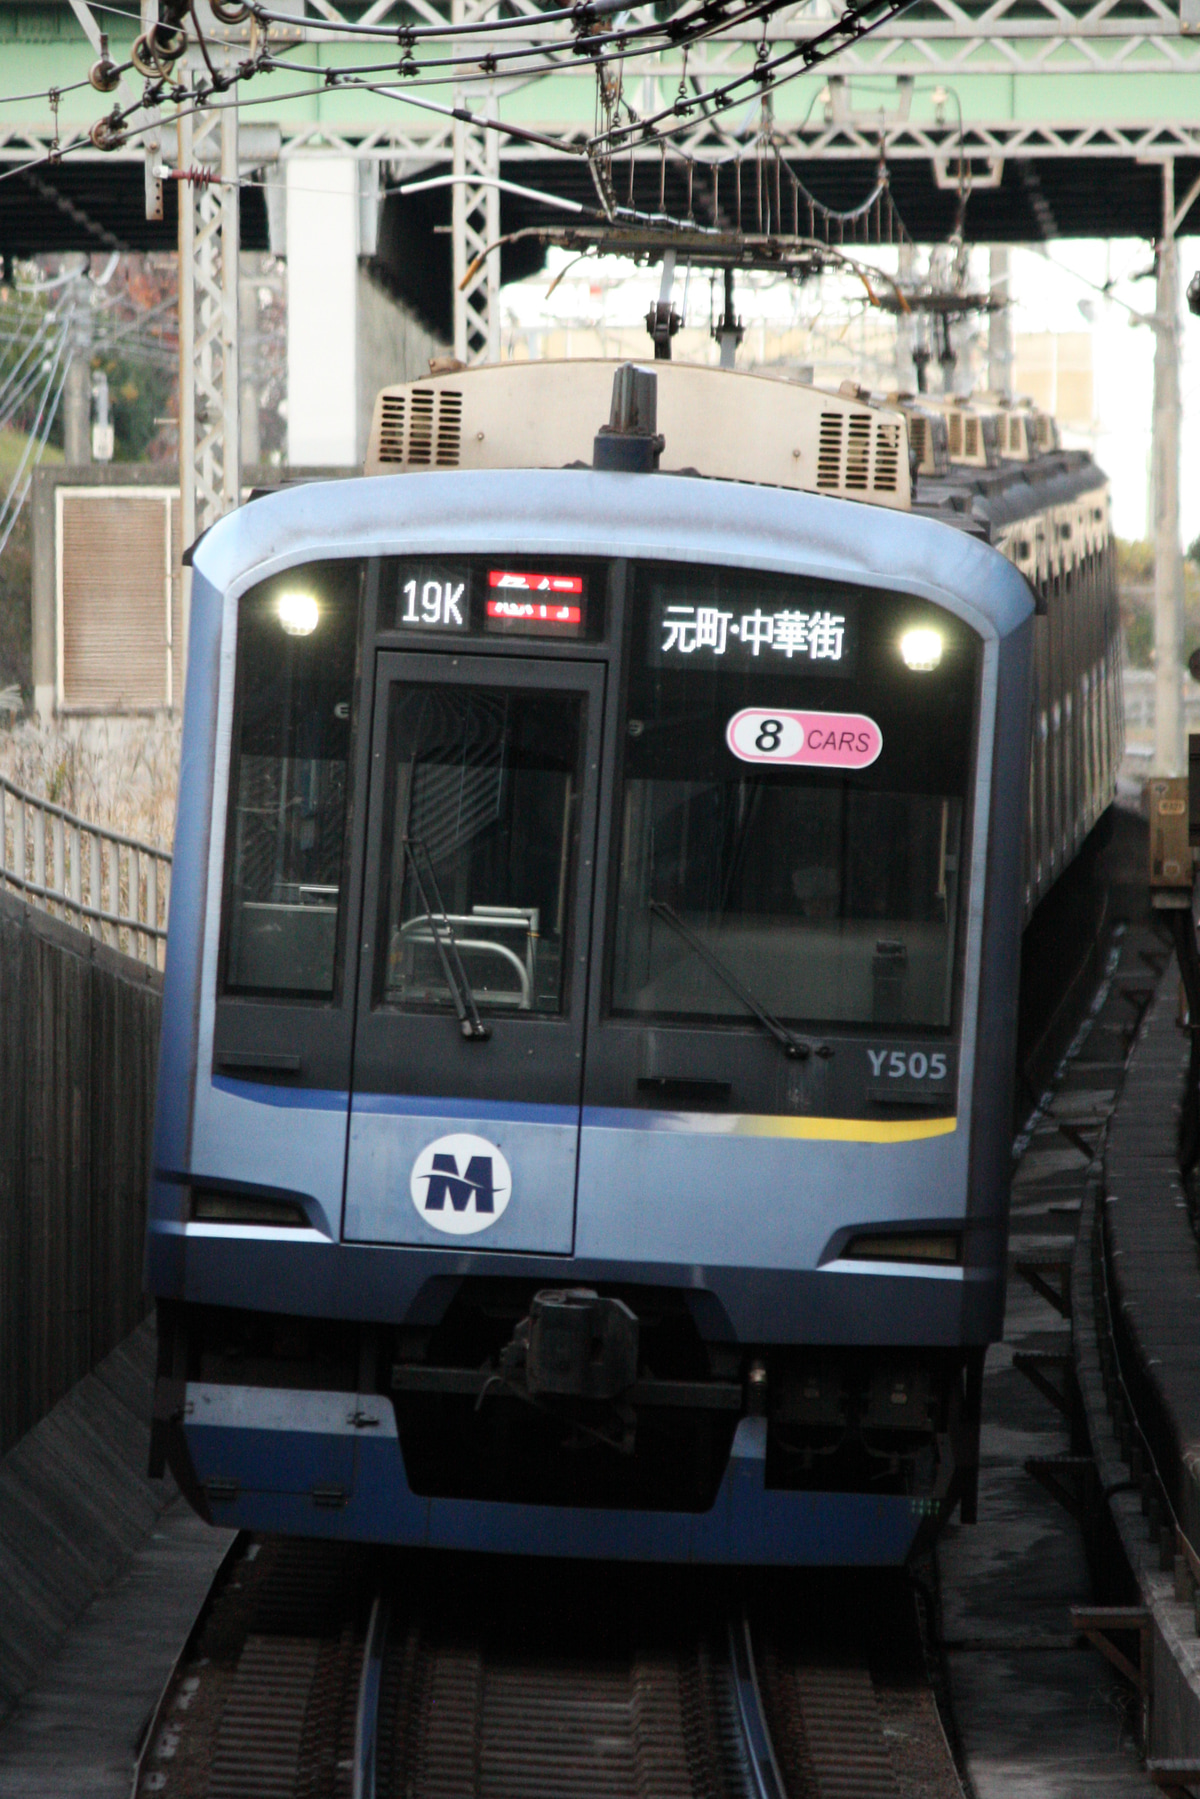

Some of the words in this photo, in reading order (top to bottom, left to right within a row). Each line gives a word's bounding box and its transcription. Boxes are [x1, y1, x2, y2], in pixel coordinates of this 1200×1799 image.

[402, 580, 465, 625] 19K
[755, 719, 784, 752] 8
[807, 729, 871, 752] CARS
[867, 1049, 947, 1080] Y505
[423, 1153, 496, 1214] M
